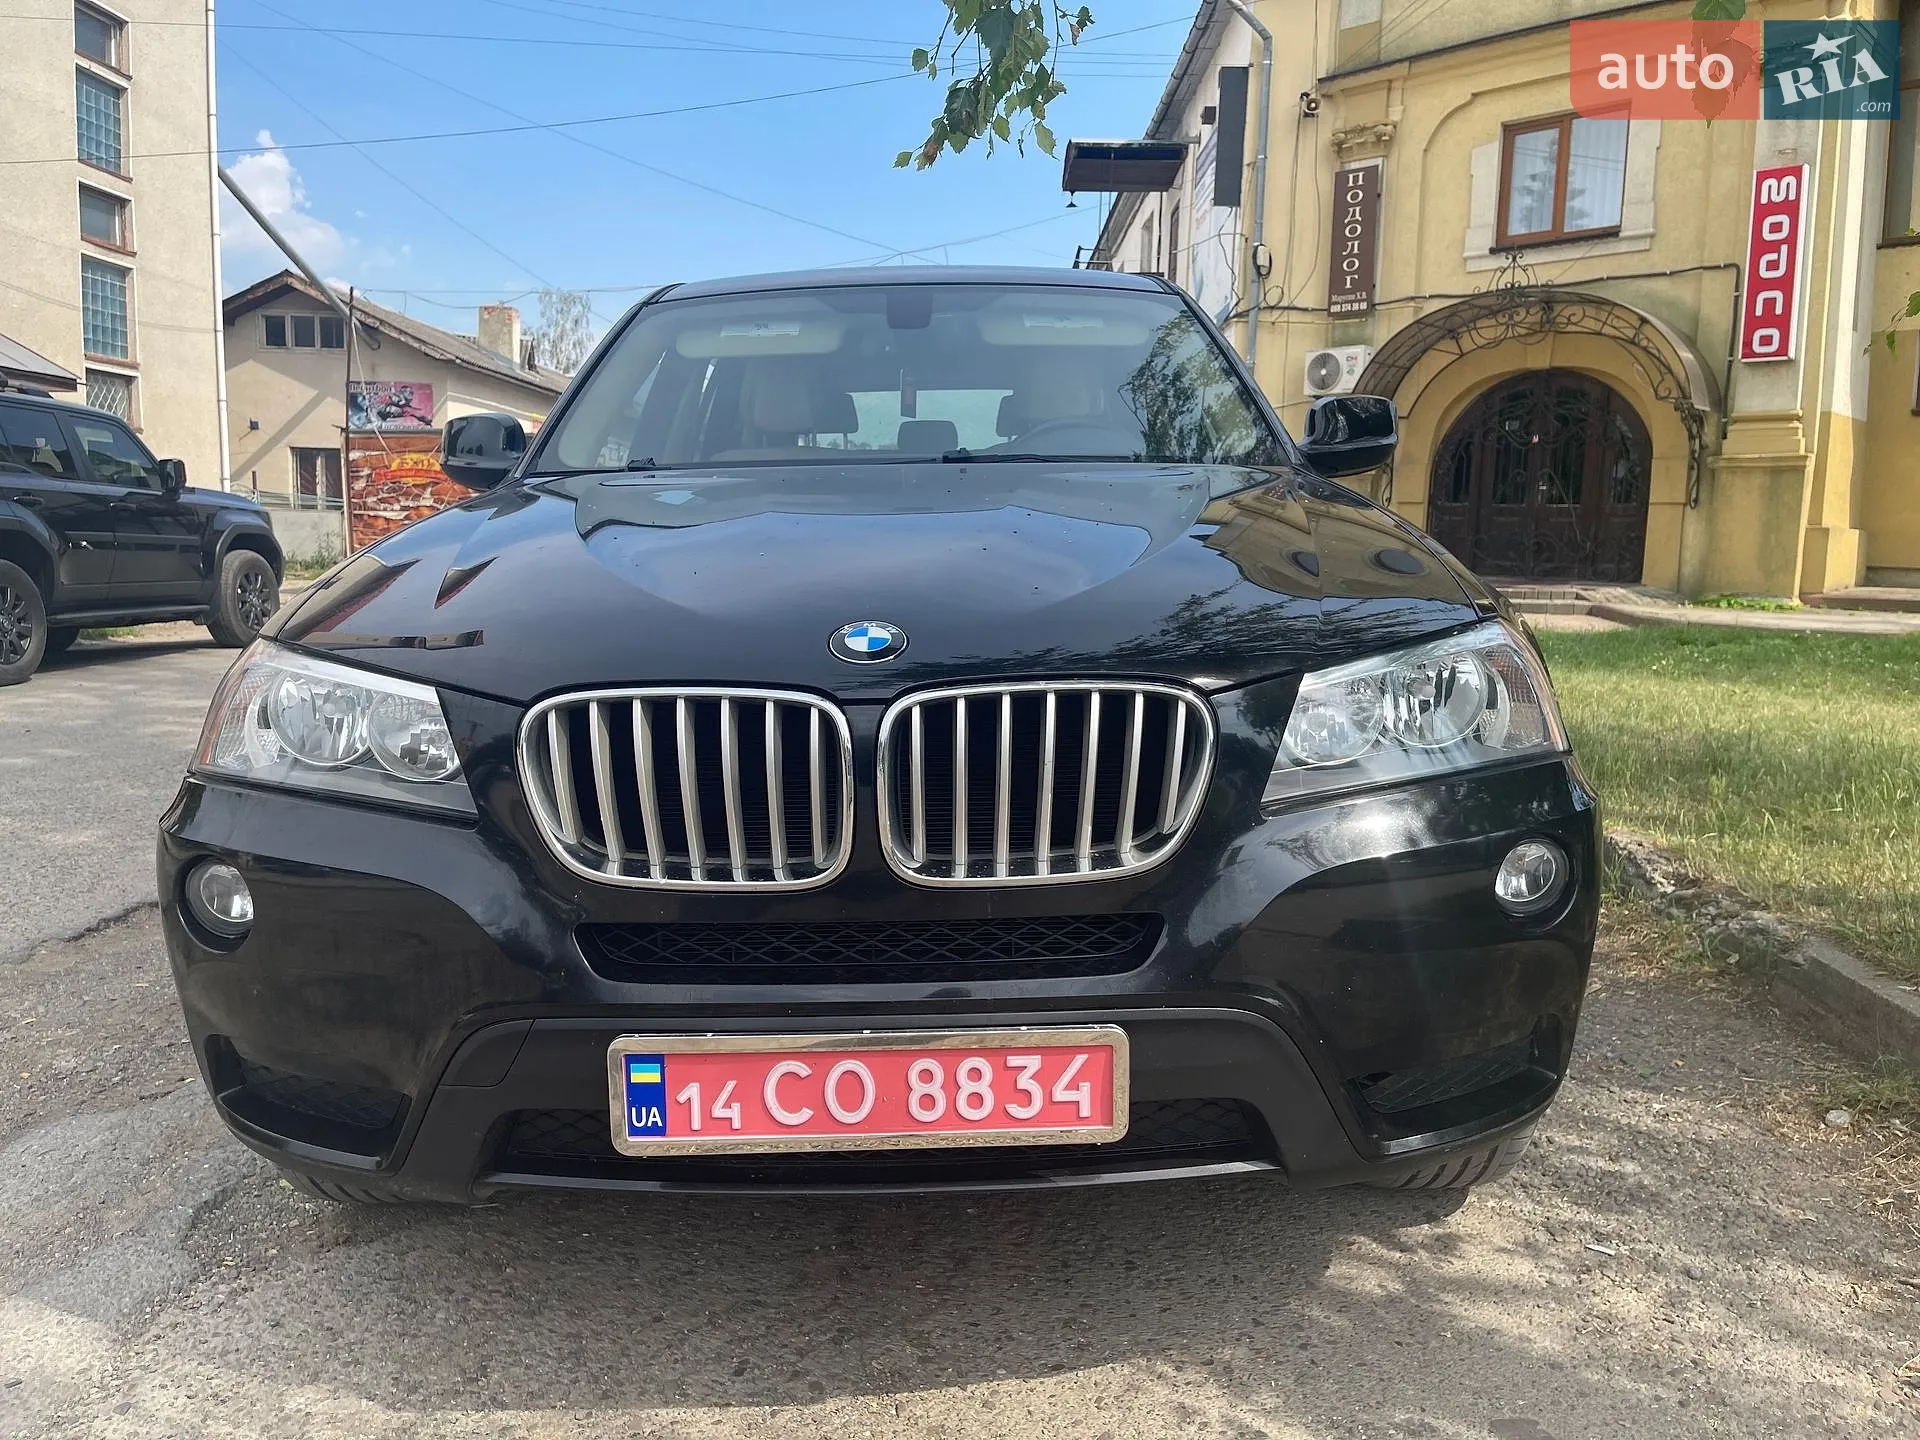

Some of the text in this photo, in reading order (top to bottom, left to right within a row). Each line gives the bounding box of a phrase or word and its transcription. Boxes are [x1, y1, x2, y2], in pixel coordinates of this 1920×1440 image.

[1342, 171, 1365, 289] ПОДОЛОГ
[631, 1107, 662, 1128] UA
[675, 1053, 1091, 1131] 14 CO 8834
